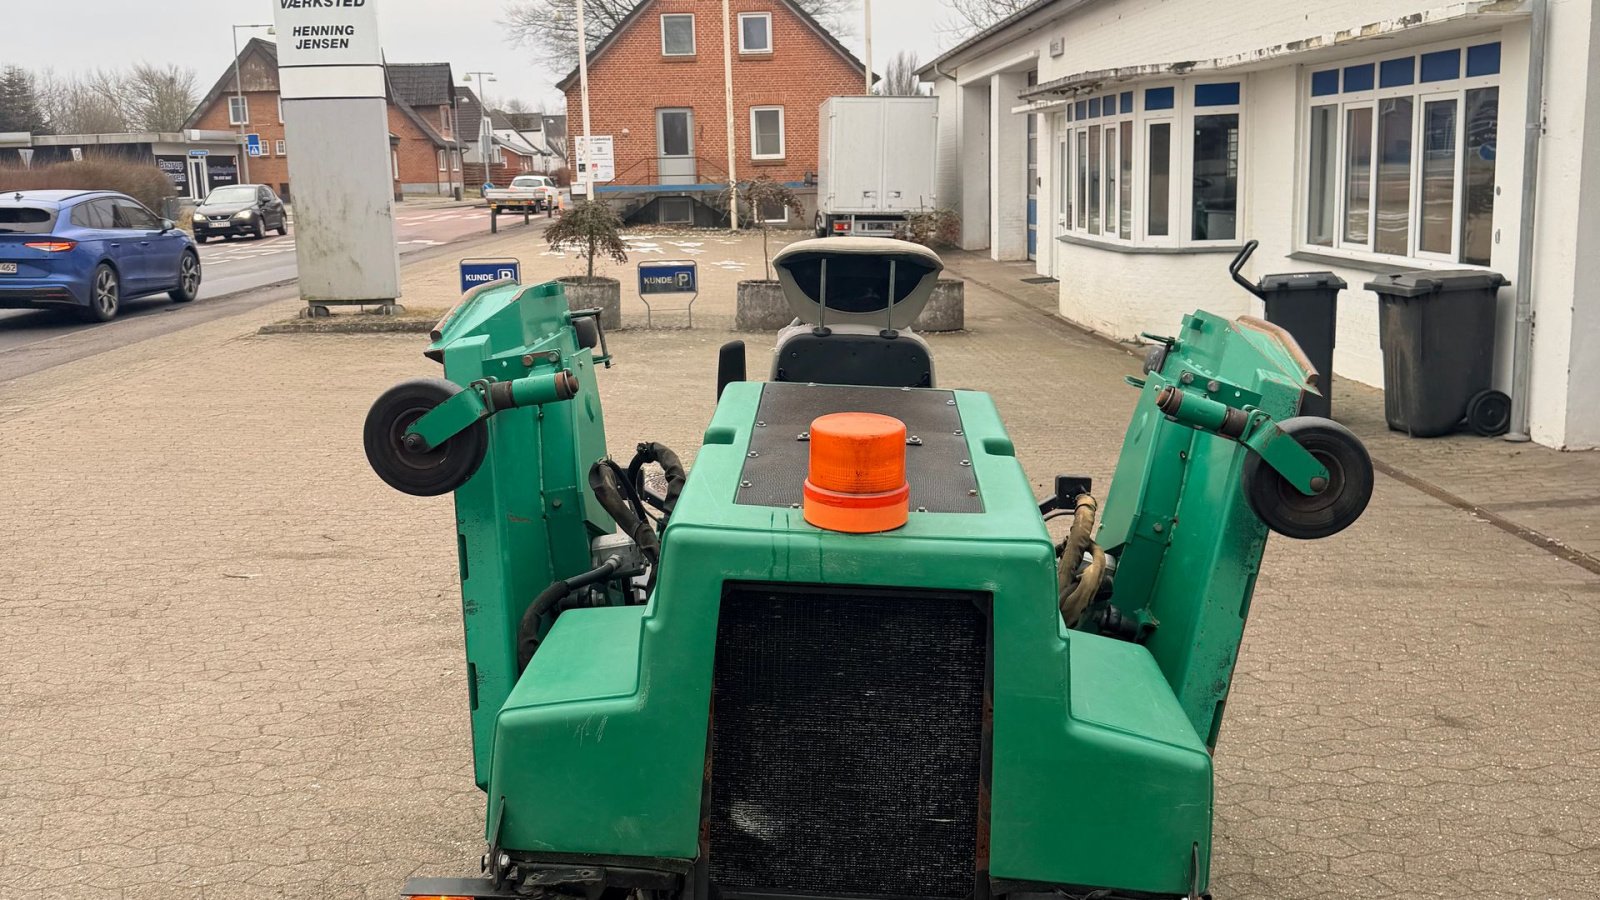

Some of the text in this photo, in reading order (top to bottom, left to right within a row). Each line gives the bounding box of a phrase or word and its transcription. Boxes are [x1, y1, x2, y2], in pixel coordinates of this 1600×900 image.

[280, 0, 366, 8] VÆRKSTED
[293, 25, 355, 36] HENNING
[295, 38, 349, 49] JENSEN
[465, 273, 495, 281] KUNDE
[643, 273, 689, 286] KUNDE P
